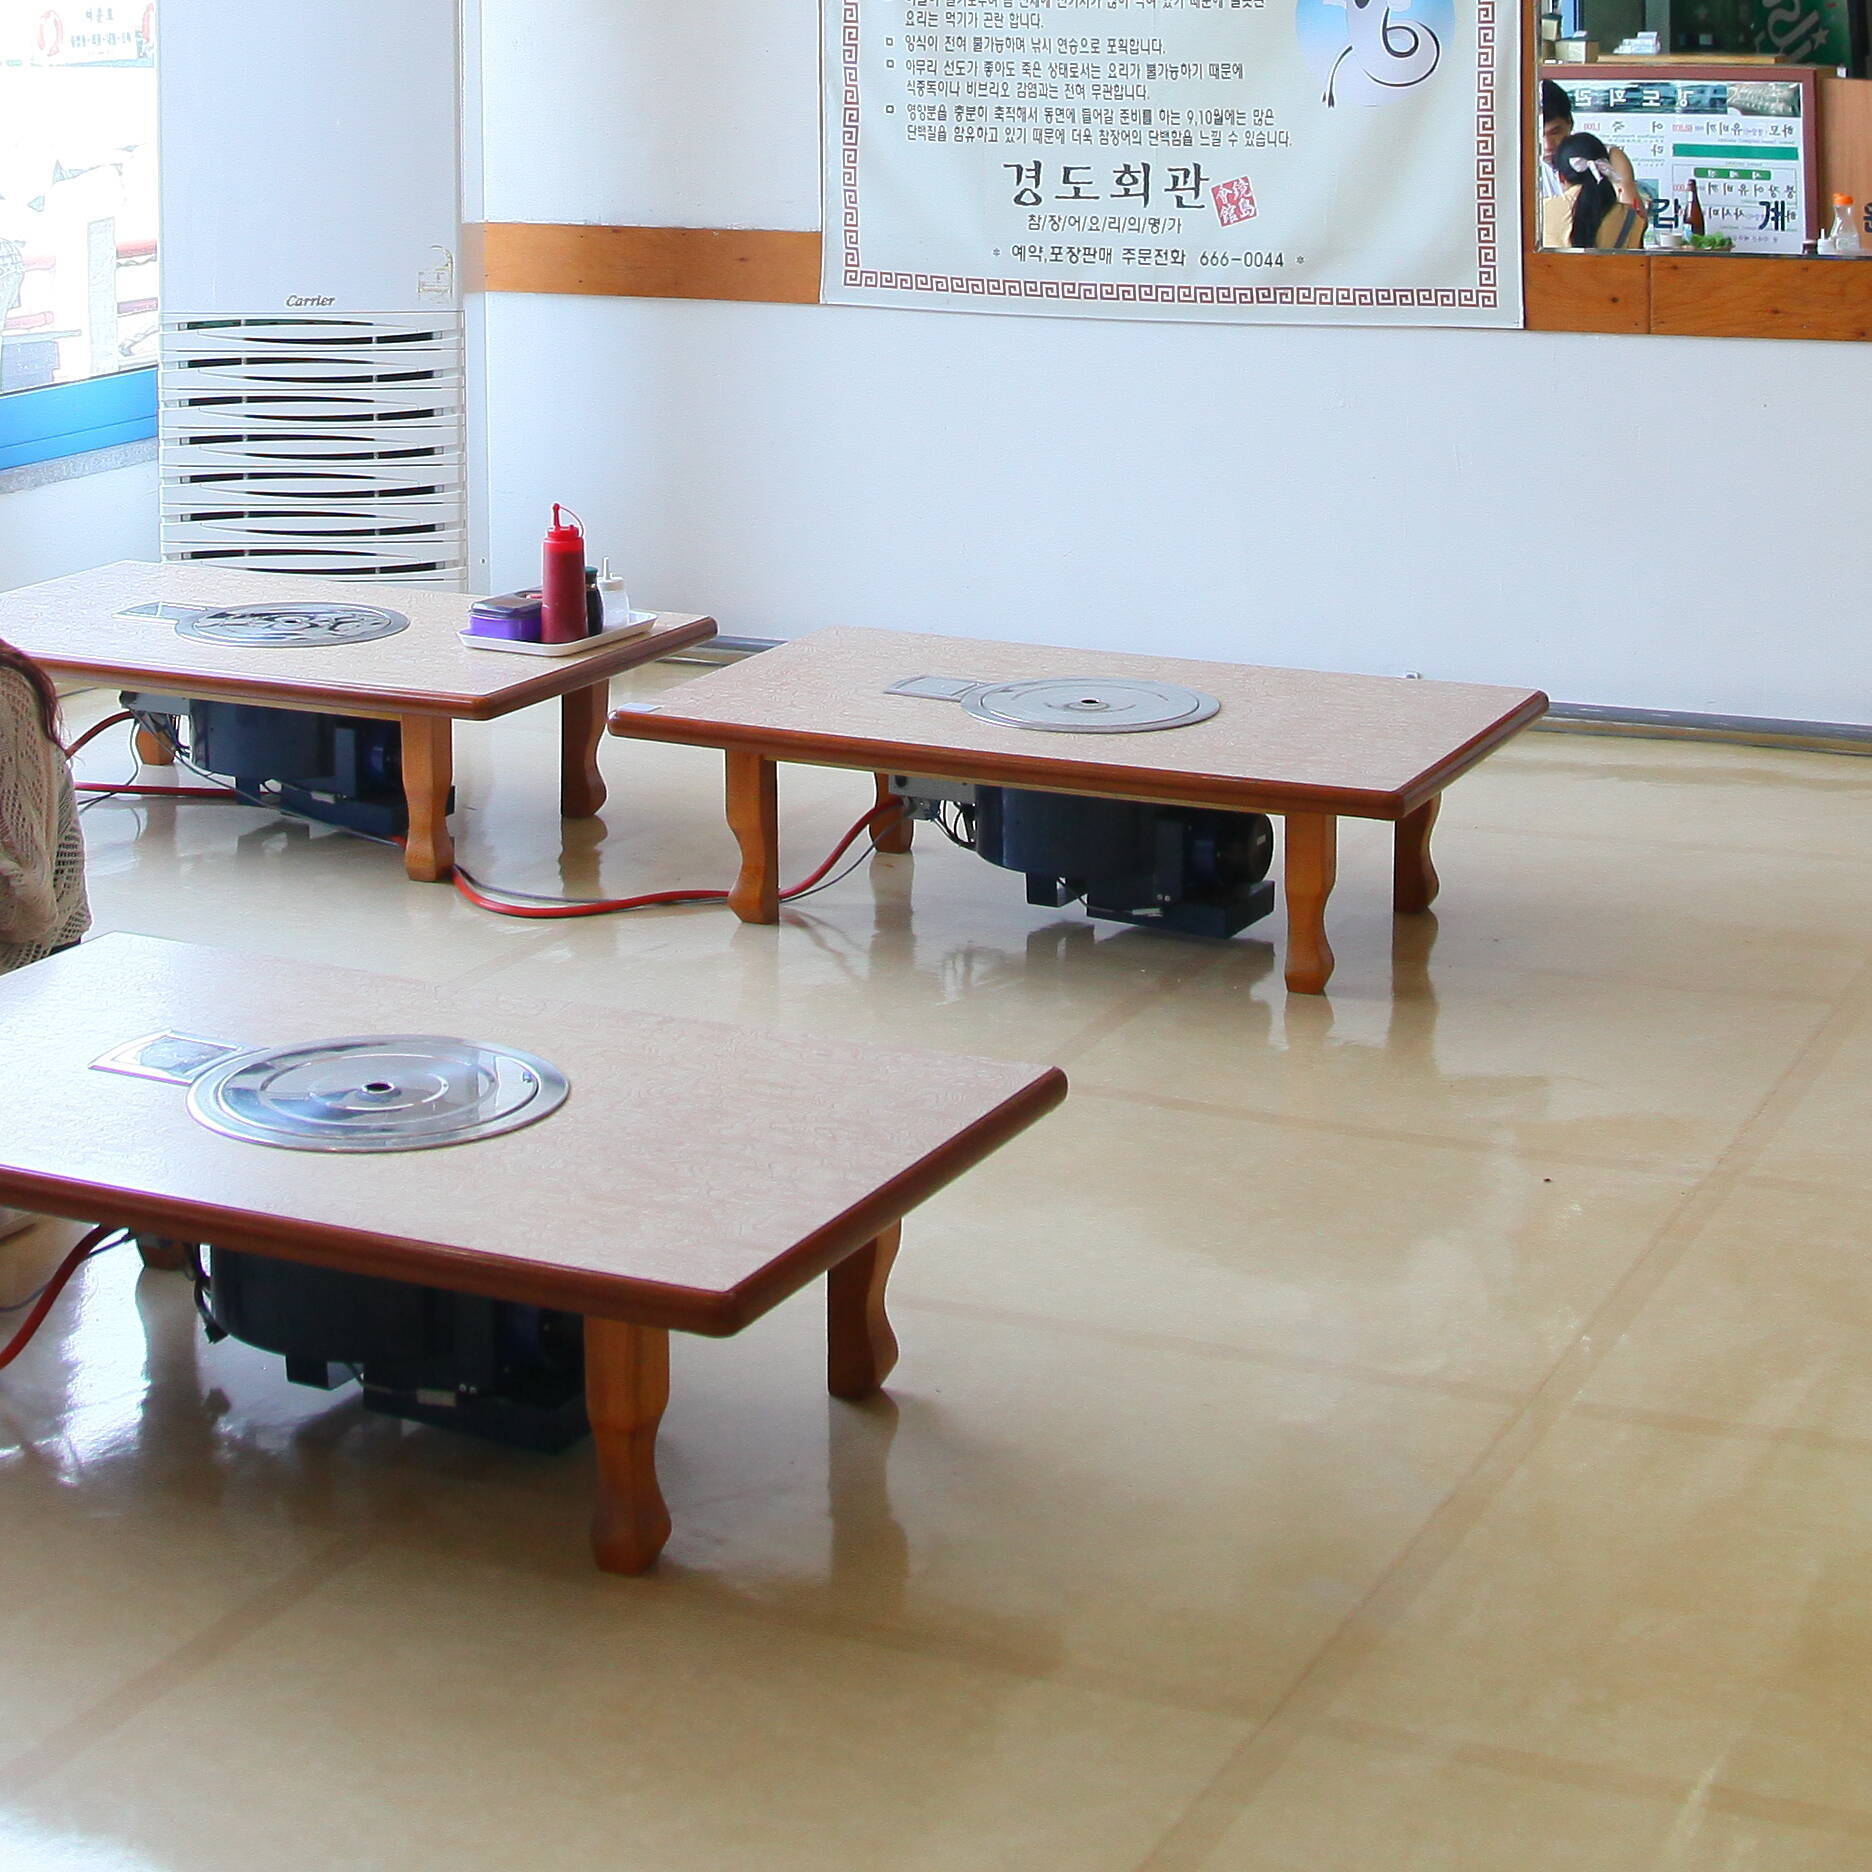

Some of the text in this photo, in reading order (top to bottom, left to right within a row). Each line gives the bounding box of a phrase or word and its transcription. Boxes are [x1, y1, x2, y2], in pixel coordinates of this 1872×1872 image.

[904, 12, 939, 27] 요리는
[945, 12, 978, 27] 먹기가
[982, 13, 1004, 27] 곤란
[904, 36, 938, 51] 양식이
[1030, 37, 1052, 52] 낚시
[1056, 38, 1101, 53] 연승으로
[905, 60, 938, 75] 아무리
[943, 61, 978, 76] 선도가
[983, 61, 1016, 76] 좋아도
[1021, 62, 1042, 77] 죽은
[1047, 62, 1101, 77] 상태로서는
[1107, 63, 1141, 78] 요리가
[1208, 63, 1243, 78] 때문에
[906, 81, 960, 97] 식중독이나
[965, 82, 1010, 98] 비브리오
[1016, 83, 1059, 98] 감염과는
[953, 106, 988, 121] 충분히
[1043, 107, 1076, 123] 동면에
[1252, 110, 1274, 125] 많은
[1004, 128, 1027, 143] 있기
[1032, 128, 1065, 144] 때문에
[1071, 129, 1093, 144] 더욱
[1098, 130, 1142, 145] 참장어의
[1199, 131, 1222, 146] 느낄
[1227, 131, 1238, 146] 수
[1003, 160, 1210, 209] 경도회관
[1027, 214, 1182, 234] 참/장/어/요/리/의/명/가
[1011, 244, 1284, 267] 예약,포장판매 주문전화 666-0044
[284, 293, 337, 308] Carrier
